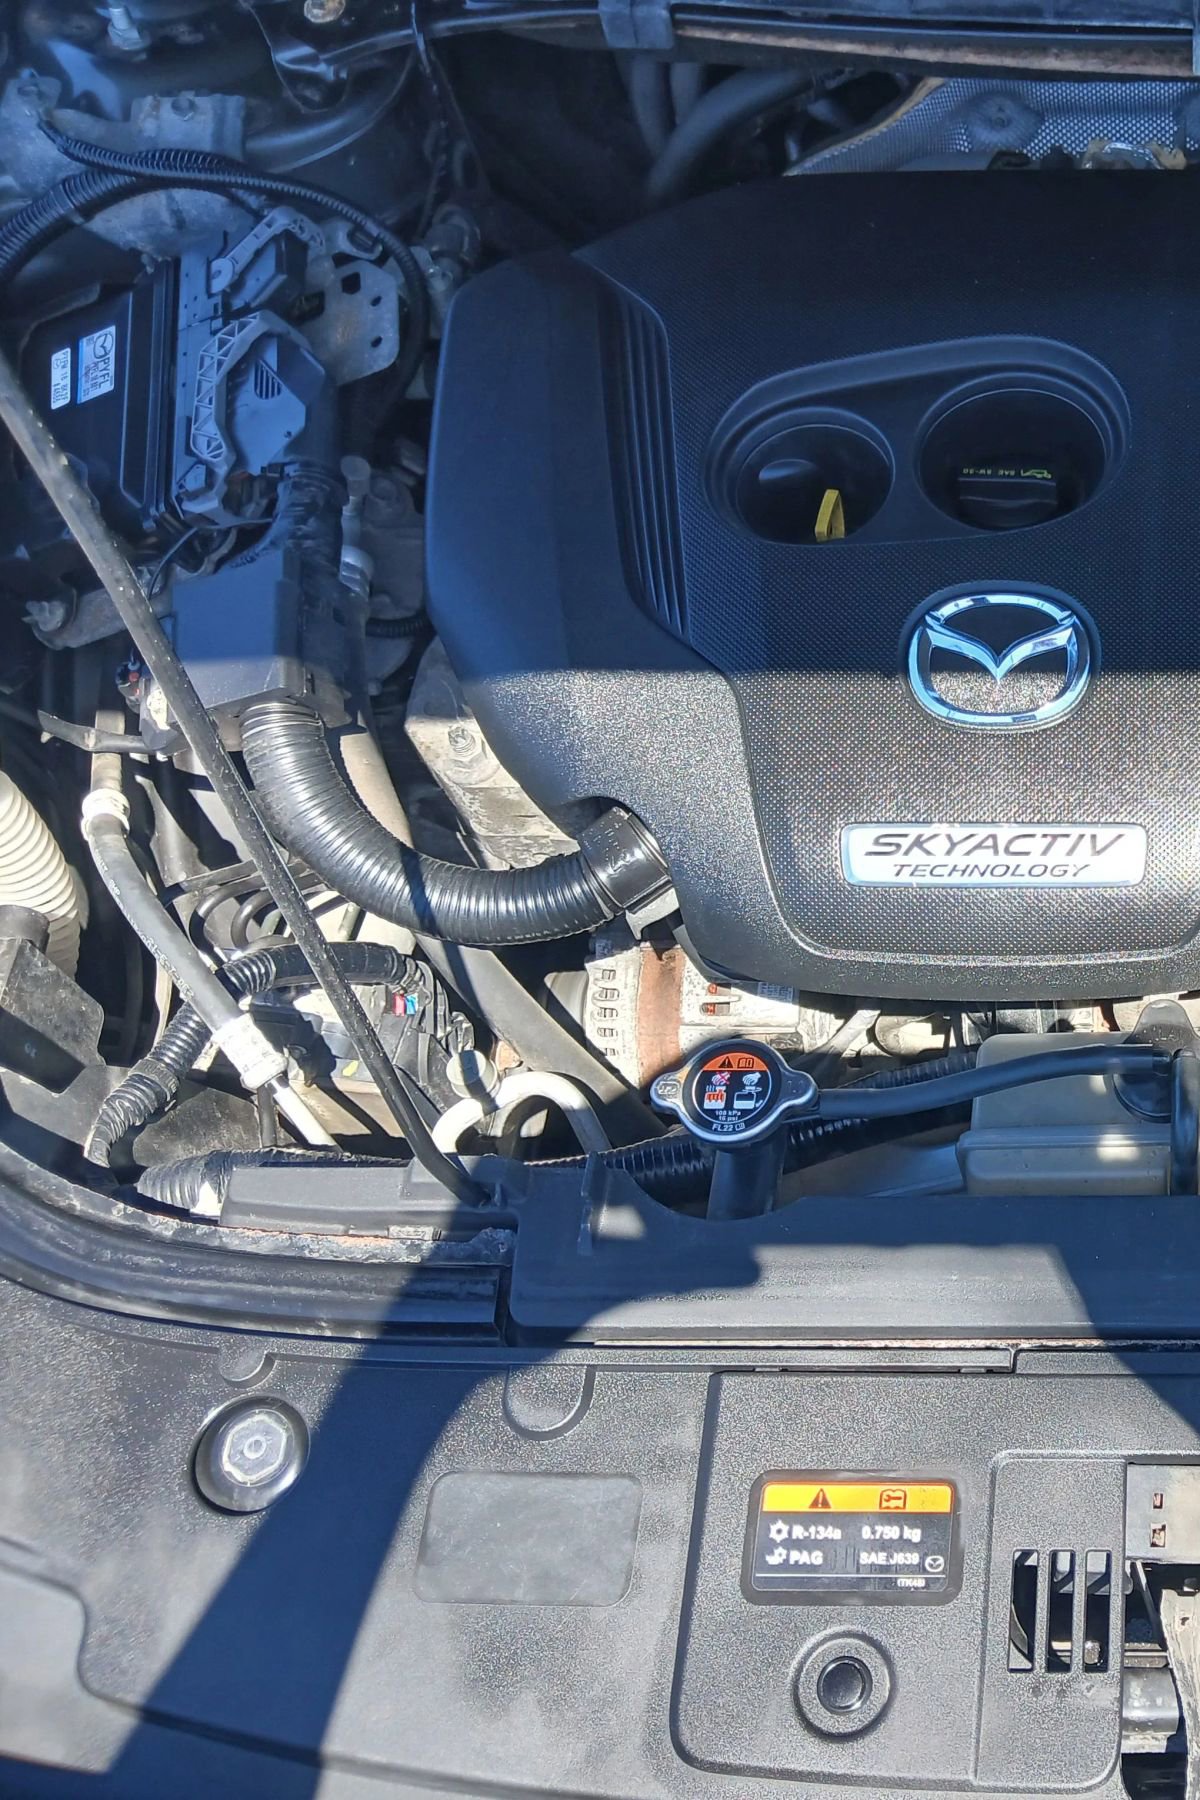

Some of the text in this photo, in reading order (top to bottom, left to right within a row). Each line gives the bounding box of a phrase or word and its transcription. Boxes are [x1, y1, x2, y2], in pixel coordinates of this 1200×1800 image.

[864, 833, 1126, 857] SKYACTIV
[893, 864, 1090, 877] TECHNOLOGY
[712, 1123, 733, 1132] FL22
[792, 1524, 842, 1540] R-134a
[862, 1524, 922, 1543] 0.750 kg
[789, 1551, 824, 1565] PAG
[860, 1552, 920, 1565] SAE J639
